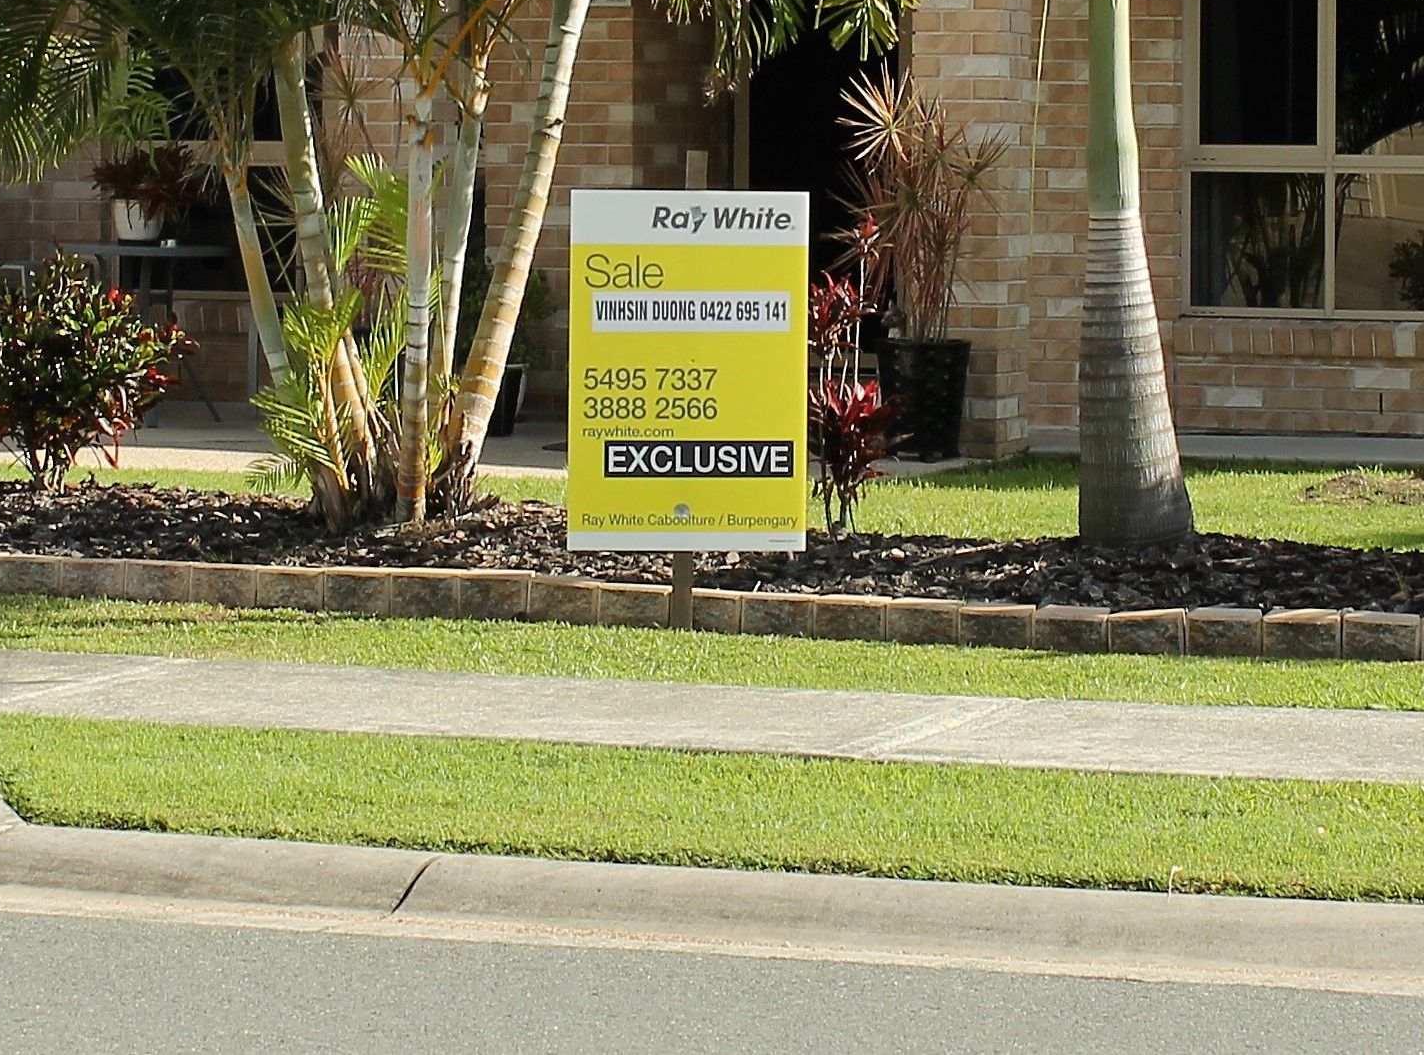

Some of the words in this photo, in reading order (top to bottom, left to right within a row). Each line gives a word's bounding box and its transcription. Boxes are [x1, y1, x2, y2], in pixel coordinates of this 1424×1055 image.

[652, 206, 708, 234] Ray
[713, 206, 792, 230] White
[584, 253, 664, 289] Sale
[595, 300, 648, 321] VINHSIN
[652, 300, 696, 321] DUONG
[699, 301, 732, 321] 0422
[736, 301, 760, 321] 695
[764, 301, 787, 321] 141
[583, 368, 647, 391] 5495
[655, 368, 718, 391] 7337
[583, 397, 647, 420] 3888
[655, 397, 718, 420] 2566
[582, 426, 674, 441] raywhite.com
[607, 445, 790, 474] EXCLUSIVE
[581, 514, 605, 529] Ray
[609, 514, 644, 526] White
[647, 514, 717, 526] Caboolture
[727, 514, 798, 529] Burpengary
